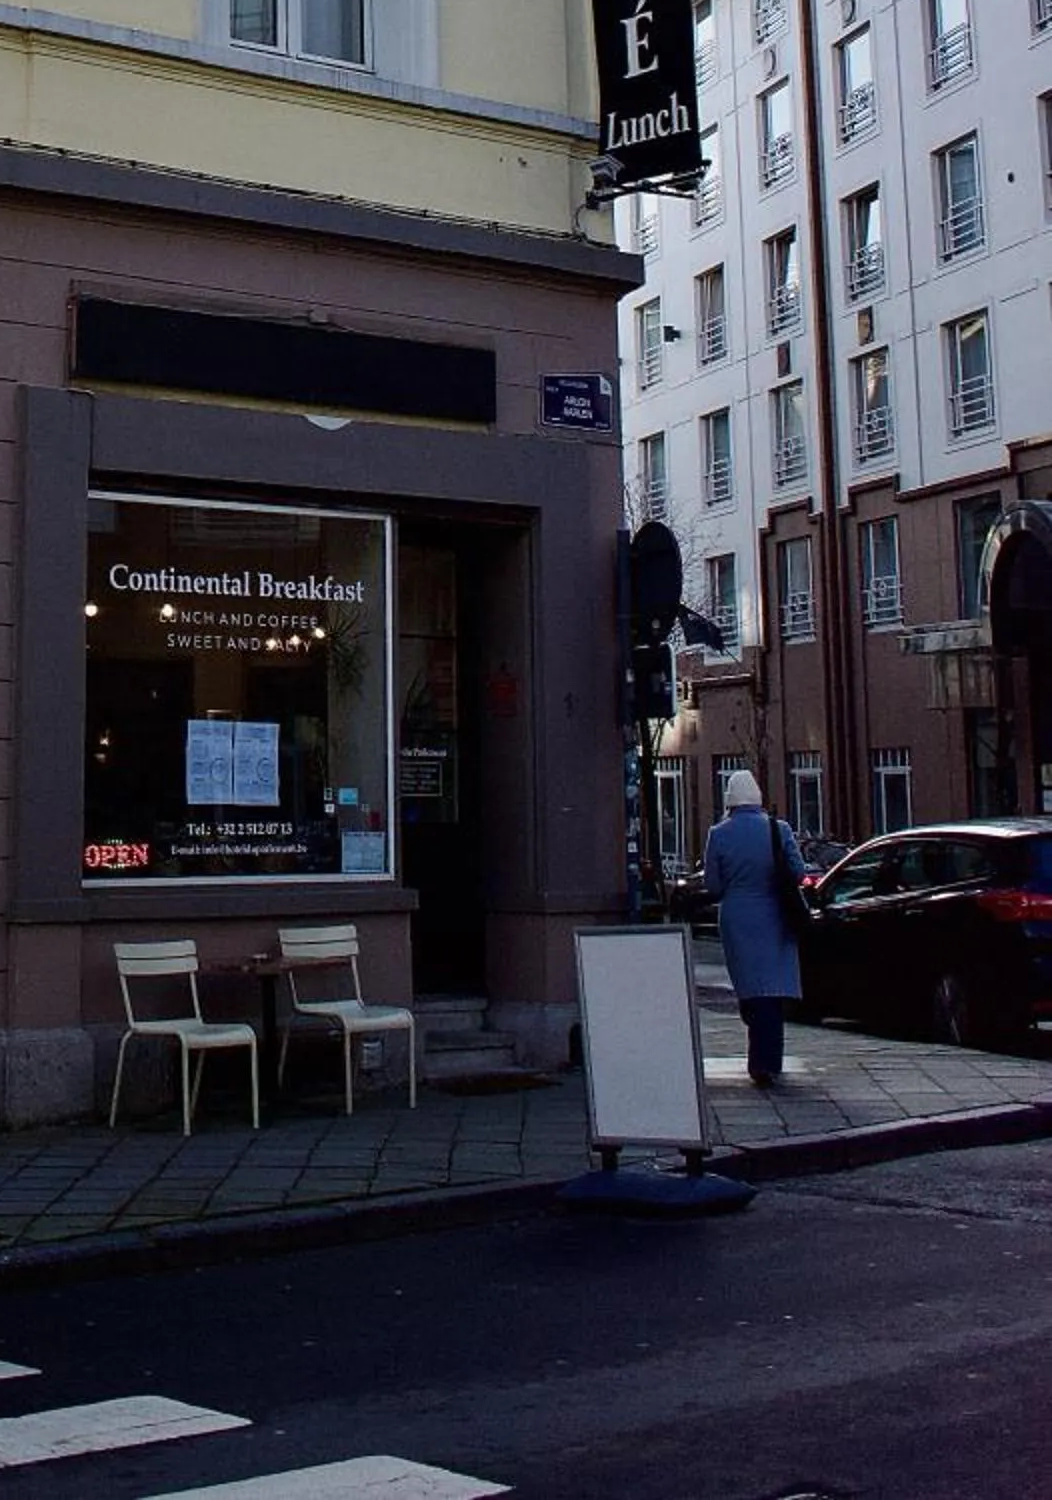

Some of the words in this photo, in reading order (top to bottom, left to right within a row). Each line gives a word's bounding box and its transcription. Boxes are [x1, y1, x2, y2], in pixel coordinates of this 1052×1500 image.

[605, 91, 691, 151] Lunch
[109, 563, 251, 597] Continental
[258, 572, 365, 603] Breakfast
[219, 613, 253, 627] AND
[257, 613, 319, 629] COFFEE
[167, 633, 223, 649] SWEET
[227, 636, 261, 651] AND
[84, 843, 149, 867] OPEN
